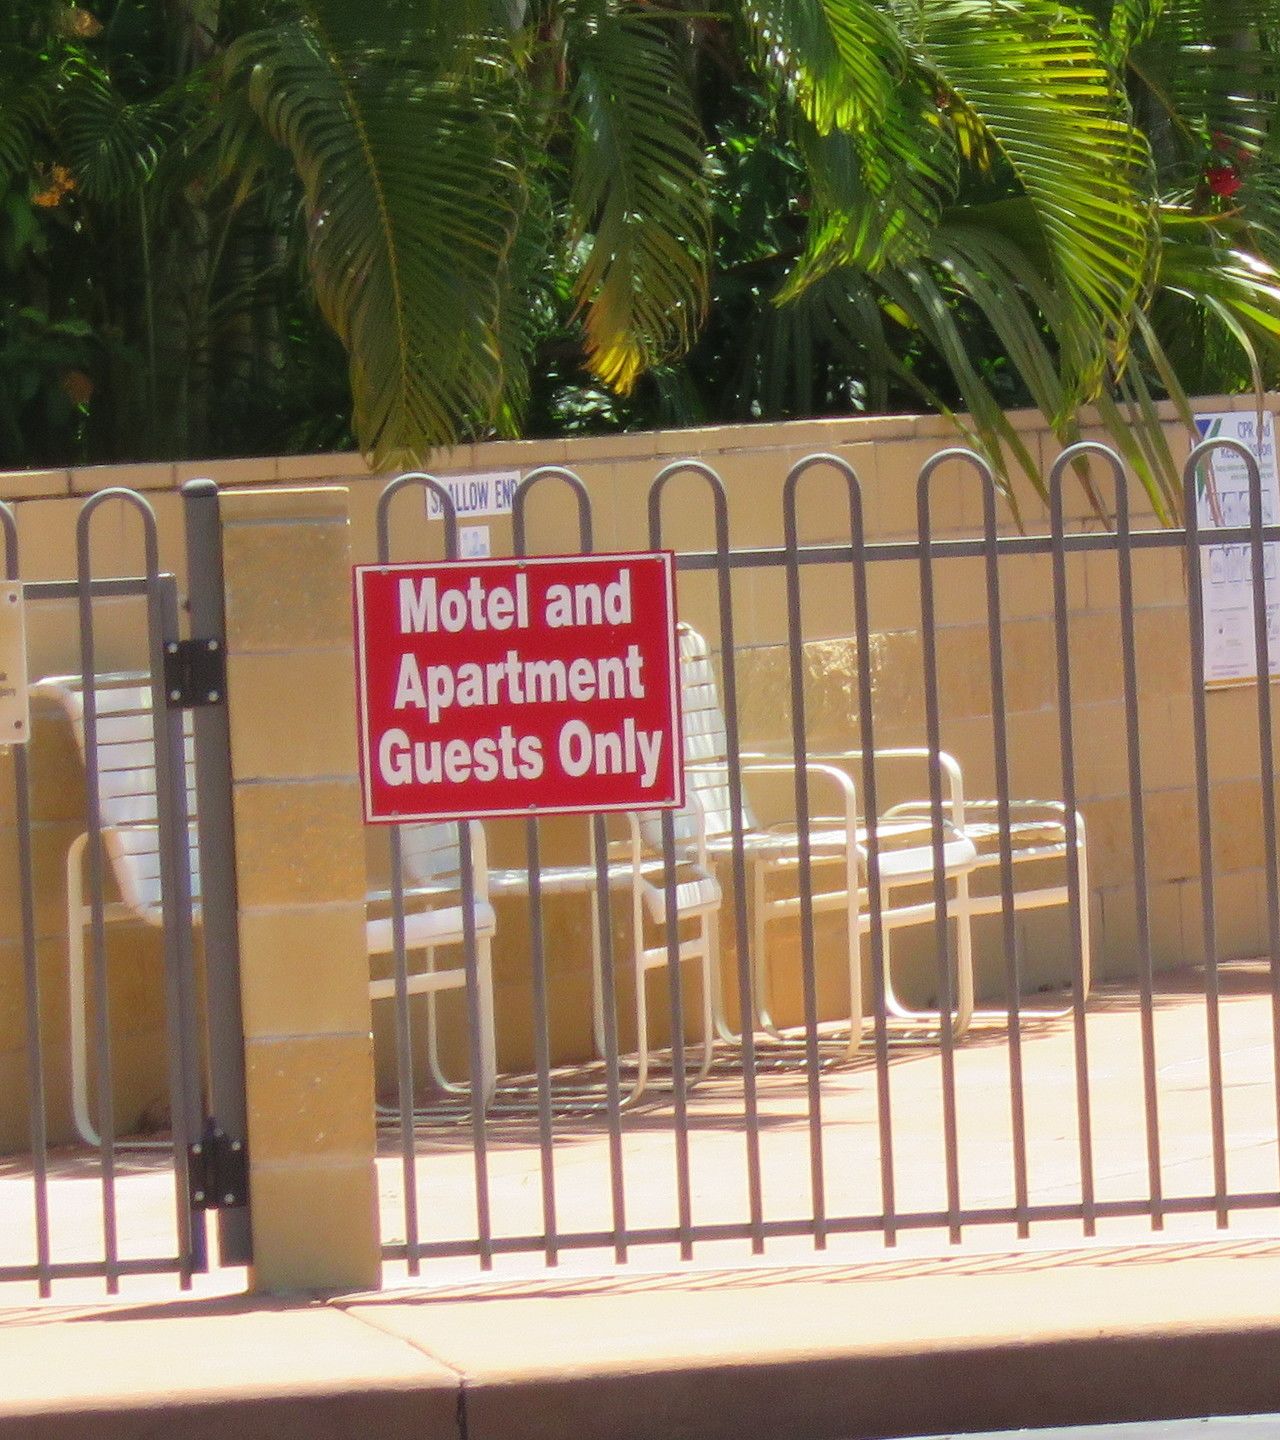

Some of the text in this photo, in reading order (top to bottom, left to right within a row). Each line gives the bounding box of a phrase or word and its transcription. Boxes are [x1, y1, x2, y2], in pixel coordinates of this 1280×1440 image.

[430, 479, 489, 514] SLLOW
[398, 568, 632, 634] Motel and
[394, 644, 645, 723] Apartment
[378, 717, 663, 788] Guests Only
